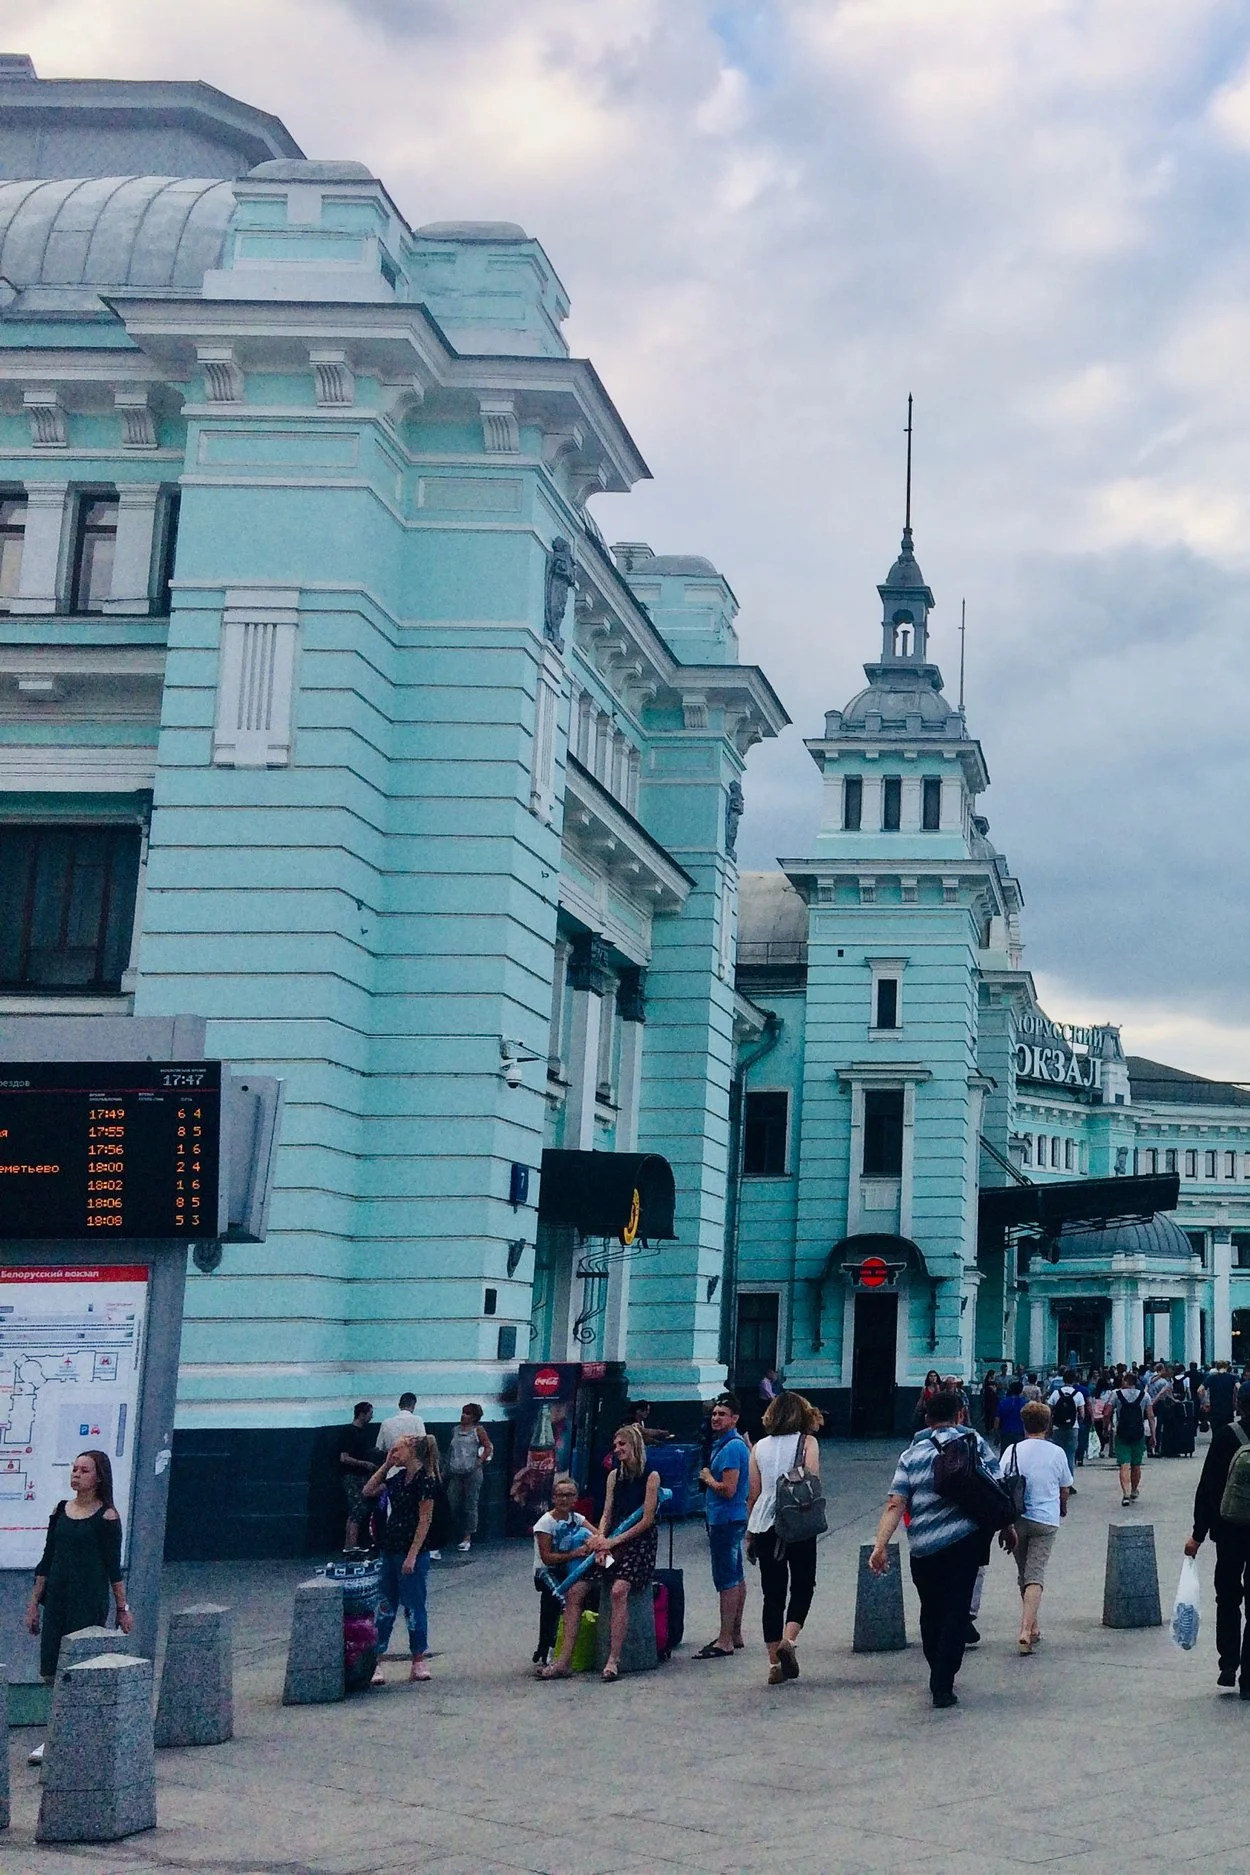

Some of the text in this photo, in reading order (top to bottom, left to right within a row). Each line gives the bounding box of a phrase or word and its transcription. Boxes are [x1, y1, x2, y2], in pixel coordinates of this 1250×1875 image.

[162, 1074, 204, 1086] 17:47
[89, 1108, 201, 1119] 17:49 6 4
[88, 1126, 125, 1137] 17:55
[177, 1126, 186, 1137] 8
[193, 1126, 202, 1137] 5
[88, 1144, 201, 1155] 17:56 1 6
[88, 1162, 124, 1173] 18:00
[176, 1162, 185, 1172] 2
[192, 1162, 201, 1172] 4
[88, 1180, 200, 1191] 18:02 1 6
[87, 1197, 200, 1208] 18:06 8 5
[87, 1215, 200, 1226] 18:08 5 3
[1, 1269, 99, 1280] Белорусский вокзал
